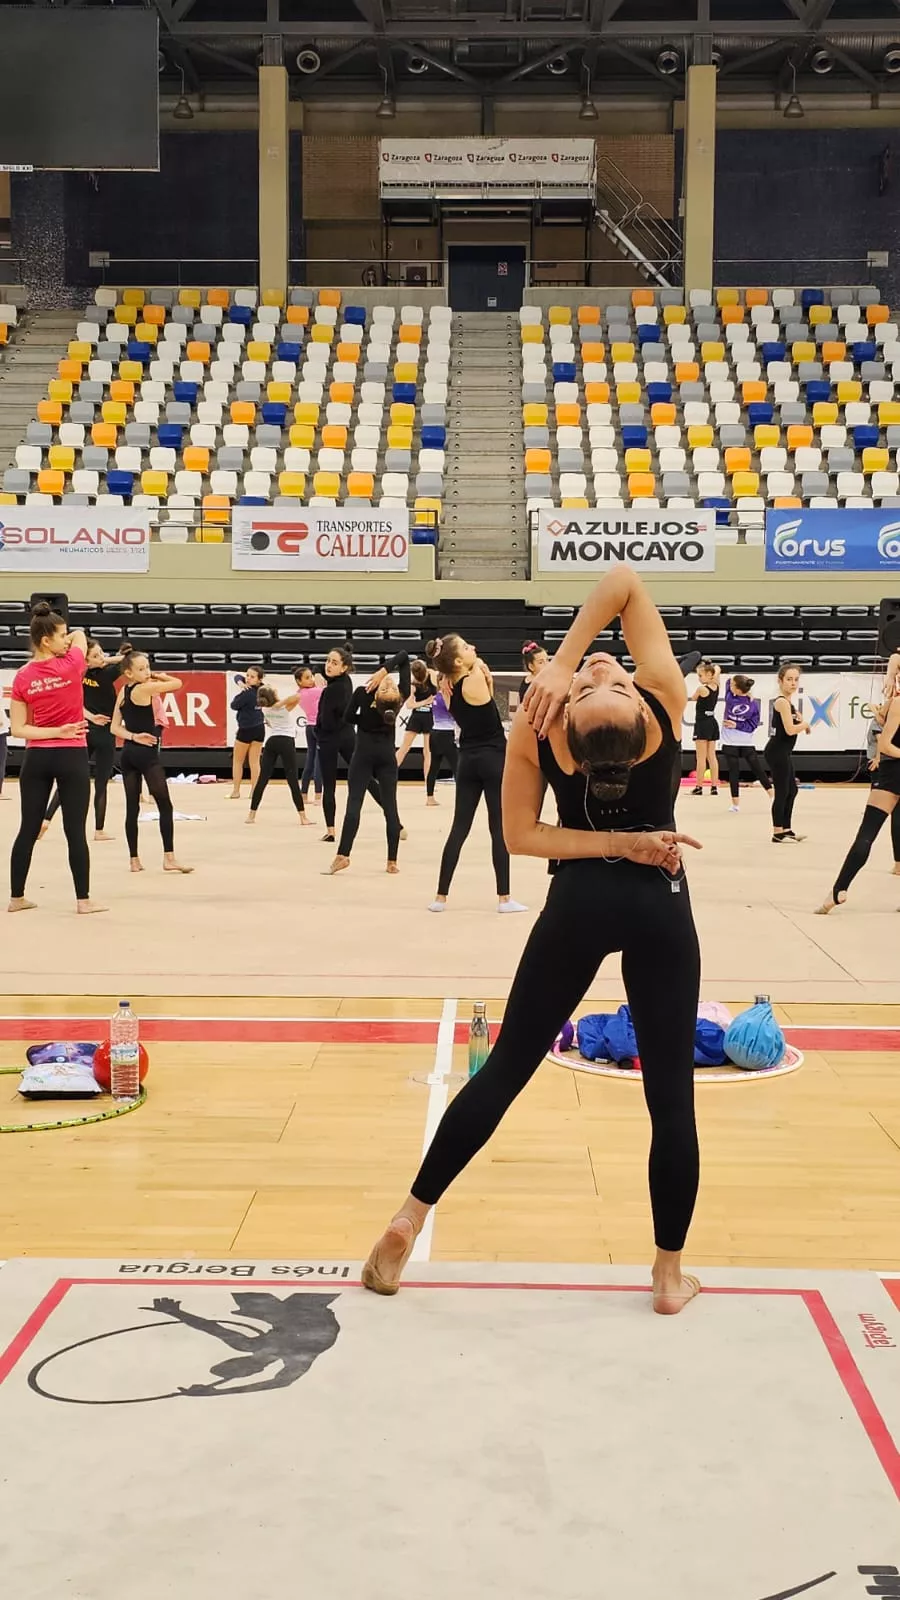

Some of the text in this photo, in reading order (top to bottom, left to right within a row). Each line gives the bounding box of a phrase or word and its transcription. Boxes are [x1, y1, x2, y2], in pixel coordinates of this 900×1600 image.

[391, 154, 420, 163] Zaragoza
[433, 154, 463, 163] Zaragoza
[518, 155, 547, 163] Zaragoza
[560, 154, 589, 163] Zaragoza
[316, 520, 393, 533] TRANSPORTES
[563, 521, 700, 536] AZULEJOS
[2, 527, 146, 545] SOLANO
[315, 534, 407, 558] CALLIZO
[550, 540, 704, 562] MONCAYO
[118, 1262, 350, 1278] Inés Bergua
